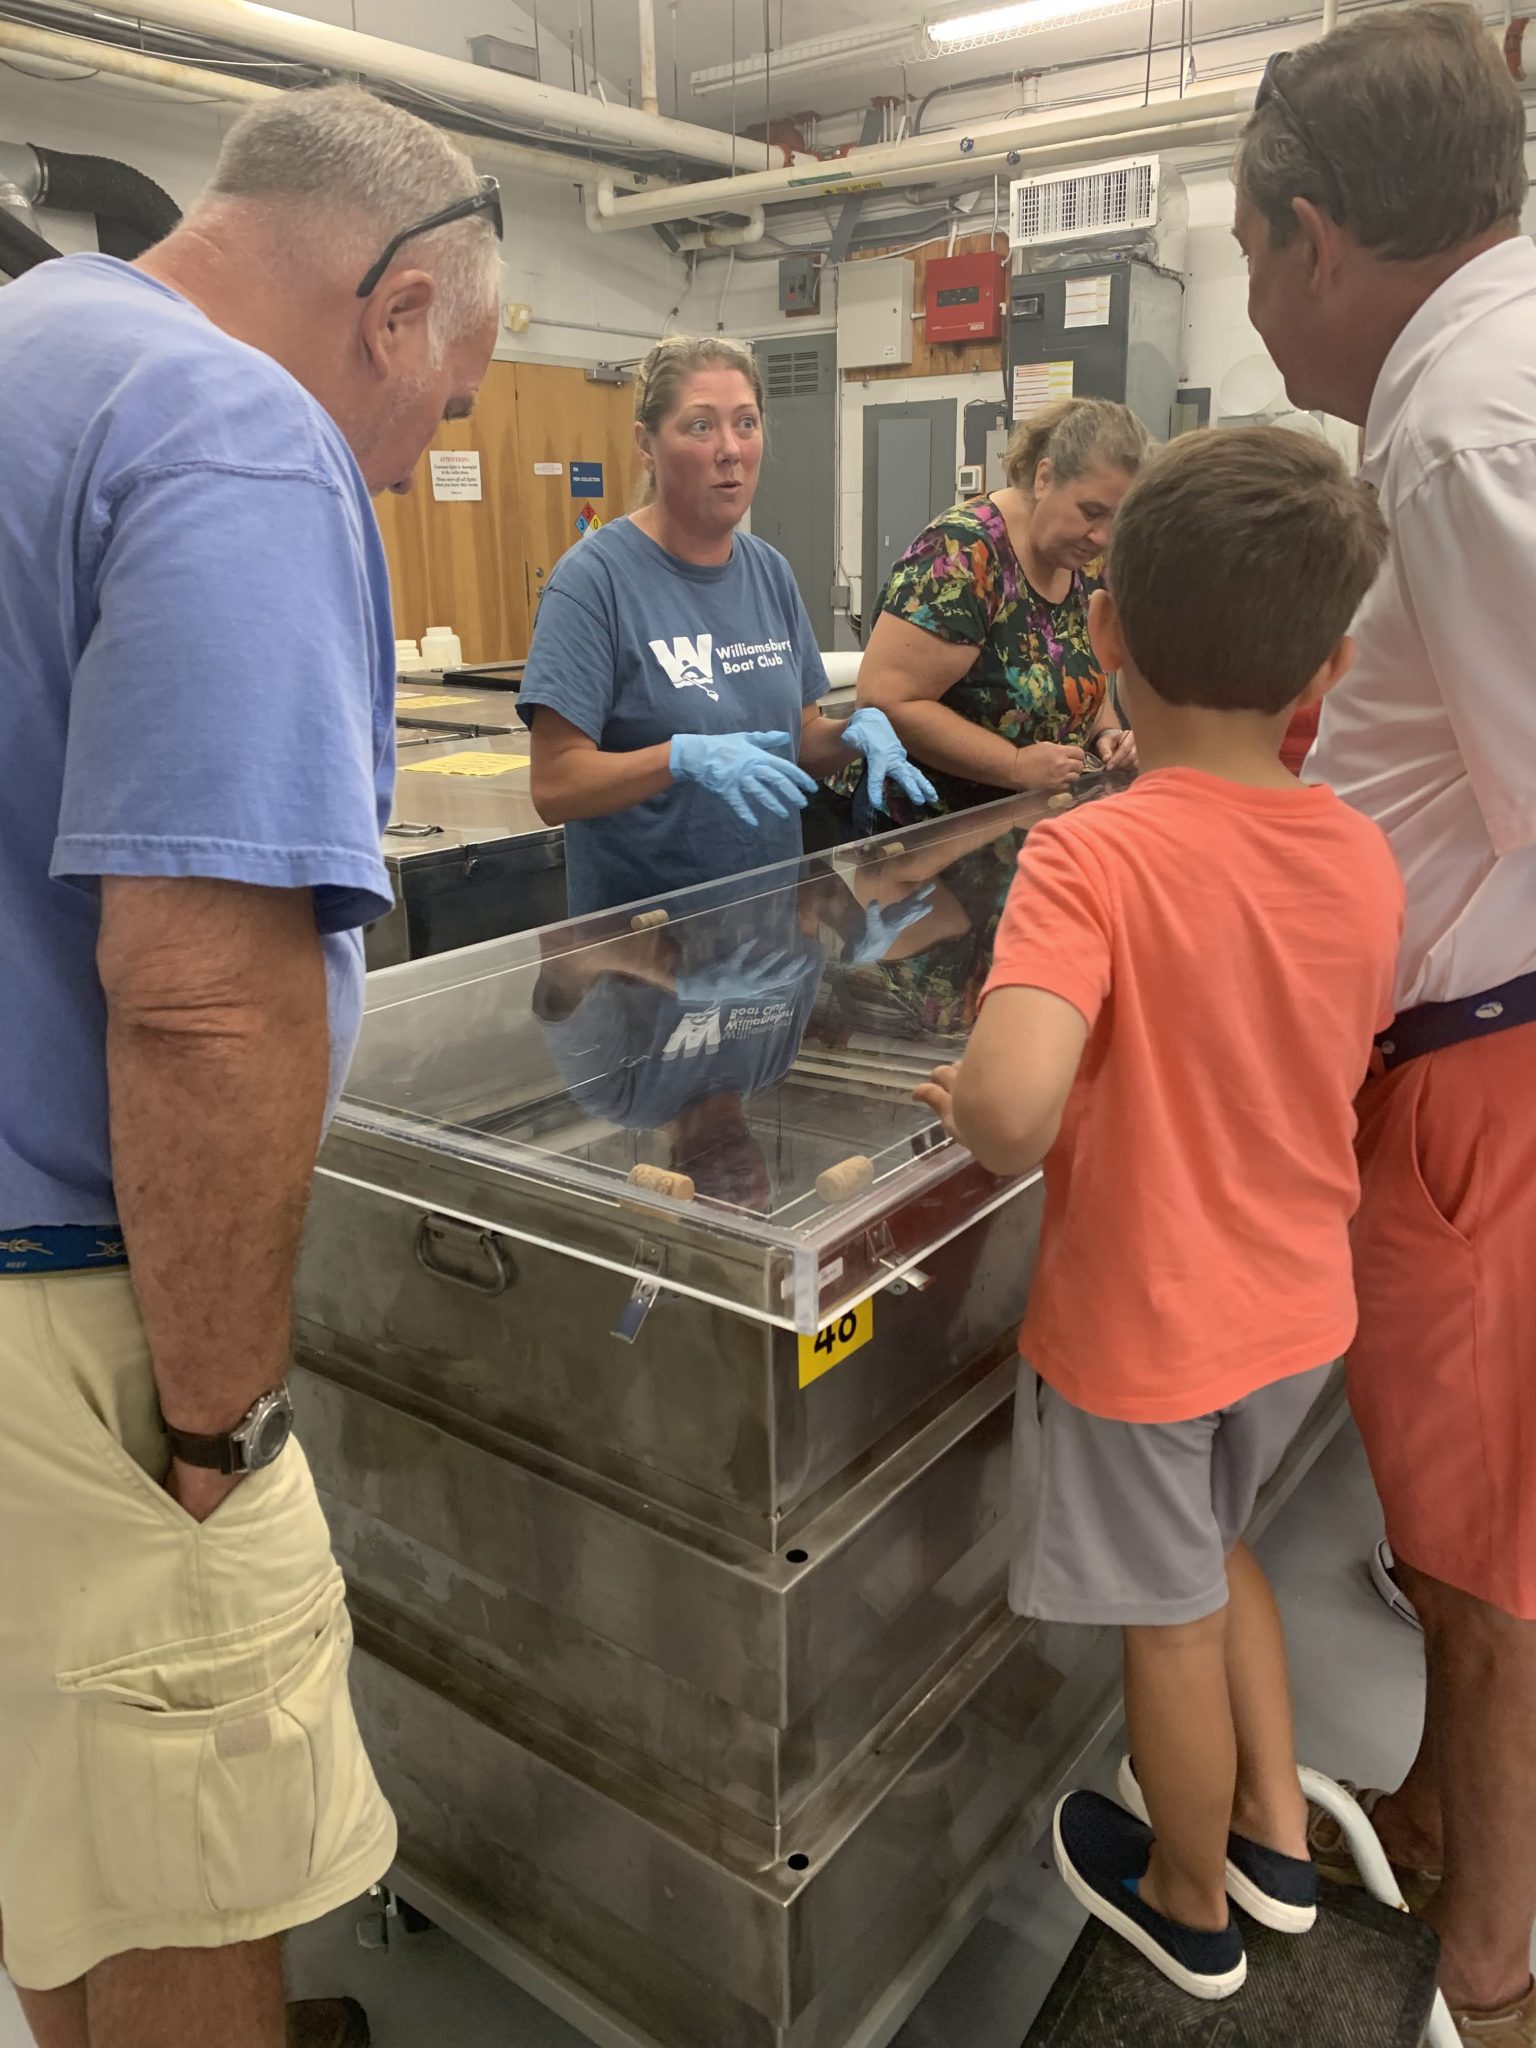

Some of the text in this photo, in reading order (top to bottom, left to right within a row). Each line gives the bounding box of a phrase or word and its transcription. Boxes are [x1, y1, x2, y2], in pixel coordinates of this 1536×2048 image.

[580, 518, 585, 531] 3
[593, 518, 599, 530] 0
[722, 653, 783, 675] Boat Club
